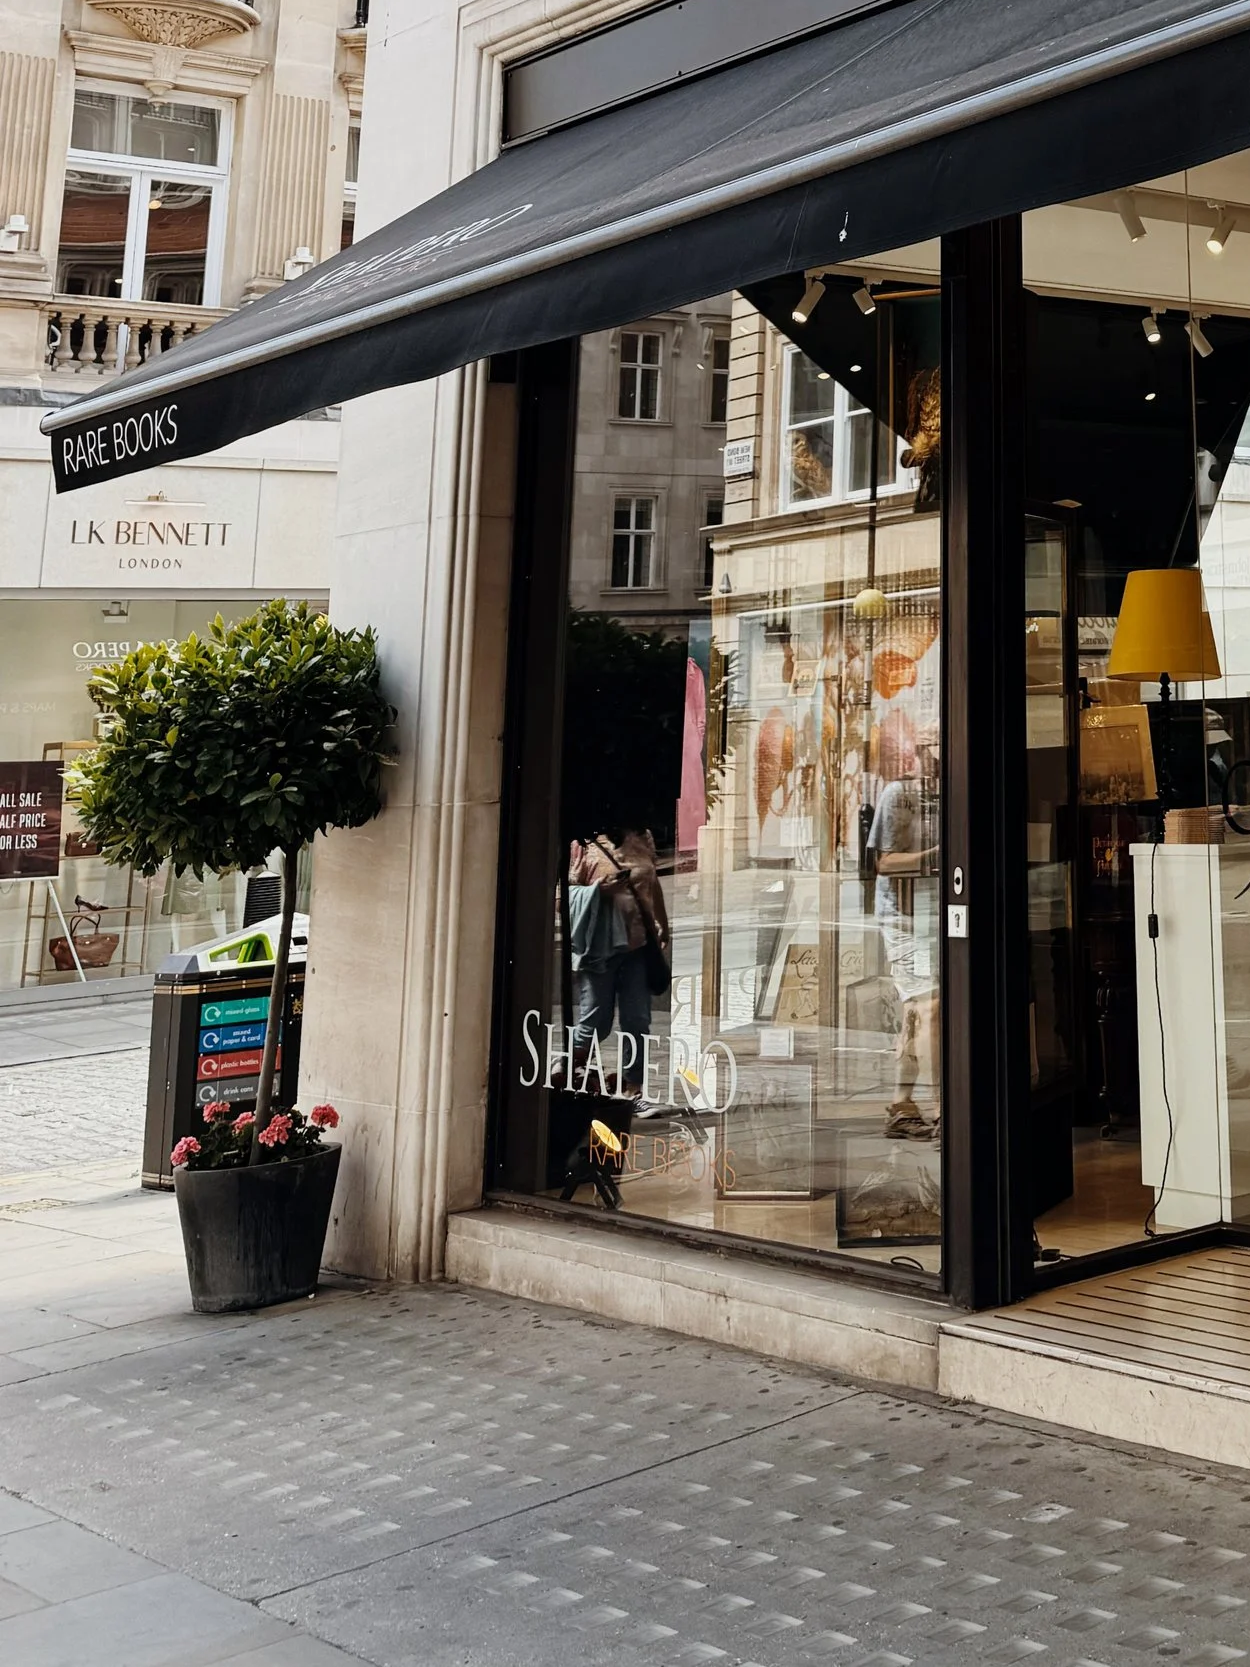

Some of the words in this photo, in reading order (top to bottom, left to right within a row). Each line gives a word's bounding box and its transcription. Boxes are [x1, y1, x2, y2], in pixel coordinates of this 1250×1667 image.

[63, 426, 110, 475] RARE
[112, 404, 178, 461] BOOKS
[71, 520, 106, 544] LK
[115, 520, 232, 546] BENNETT
[118, 558, 183, 569] LONDON
[0, 793, 17, 808] ALL
[19, 792, 42, 807] SALE
[19, 813, 47, 828] PRICE
[0, 835, 12, 850] OR
[15, 834, 38, 849] LESS
[223, 1038, 241, 1046] paper
[221, 1061, 239, 1070] plastic
[519, 1009, 738, 1115] SHAPERO
[223, 1087, 239, 1095] drink
[590, 1126, 645, 1174] RARE
[653, 1137, 737, 1189] BOOKS
